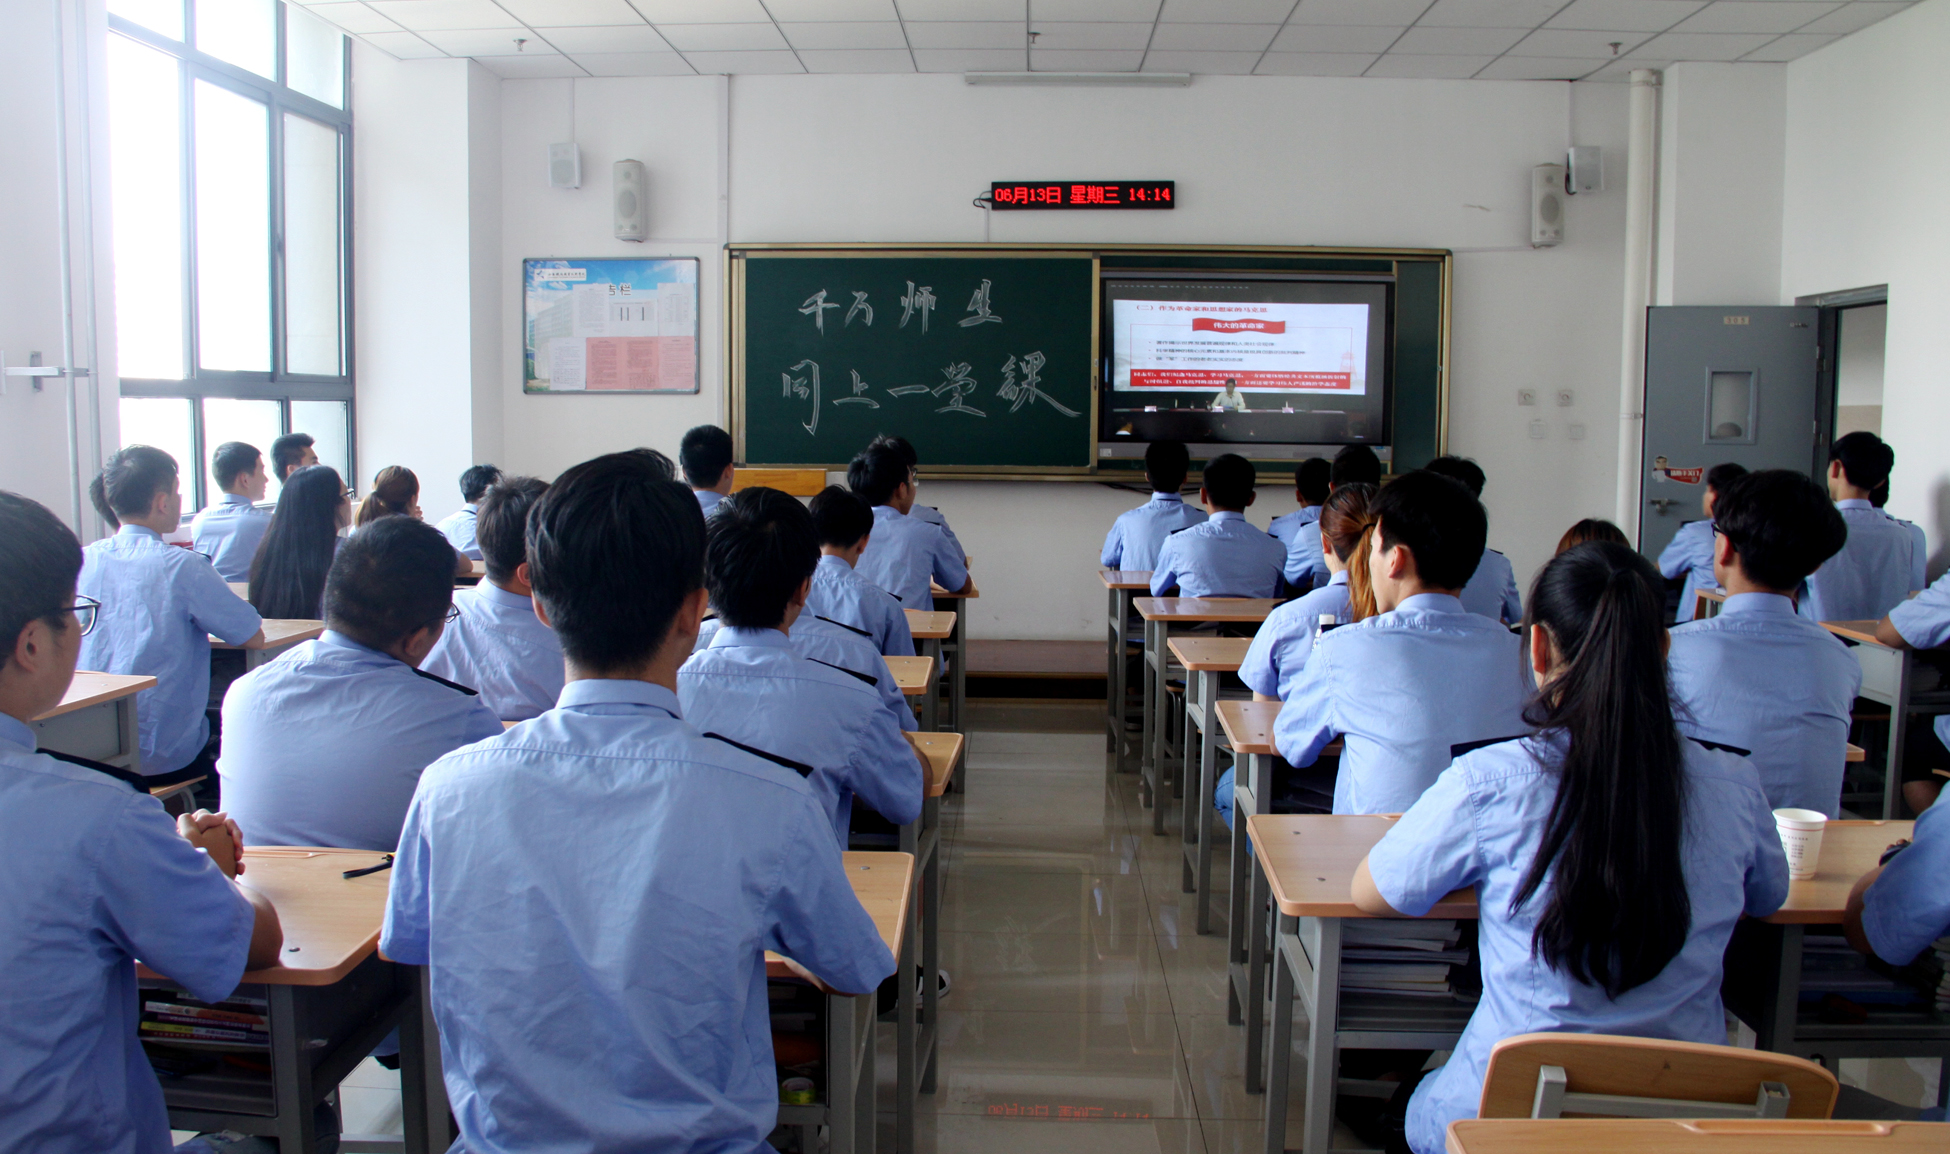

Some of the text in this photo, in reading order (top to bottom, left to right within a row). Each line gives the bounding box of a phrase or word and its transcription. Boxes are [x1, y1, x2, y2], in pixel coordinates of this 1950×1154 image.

[994, 184, 1172, 205] 06月13日 星期三 14:14
[798, 278, 1003, 336] 千万师生
[1213, 321, 1265, 329] 伟大的革命家
